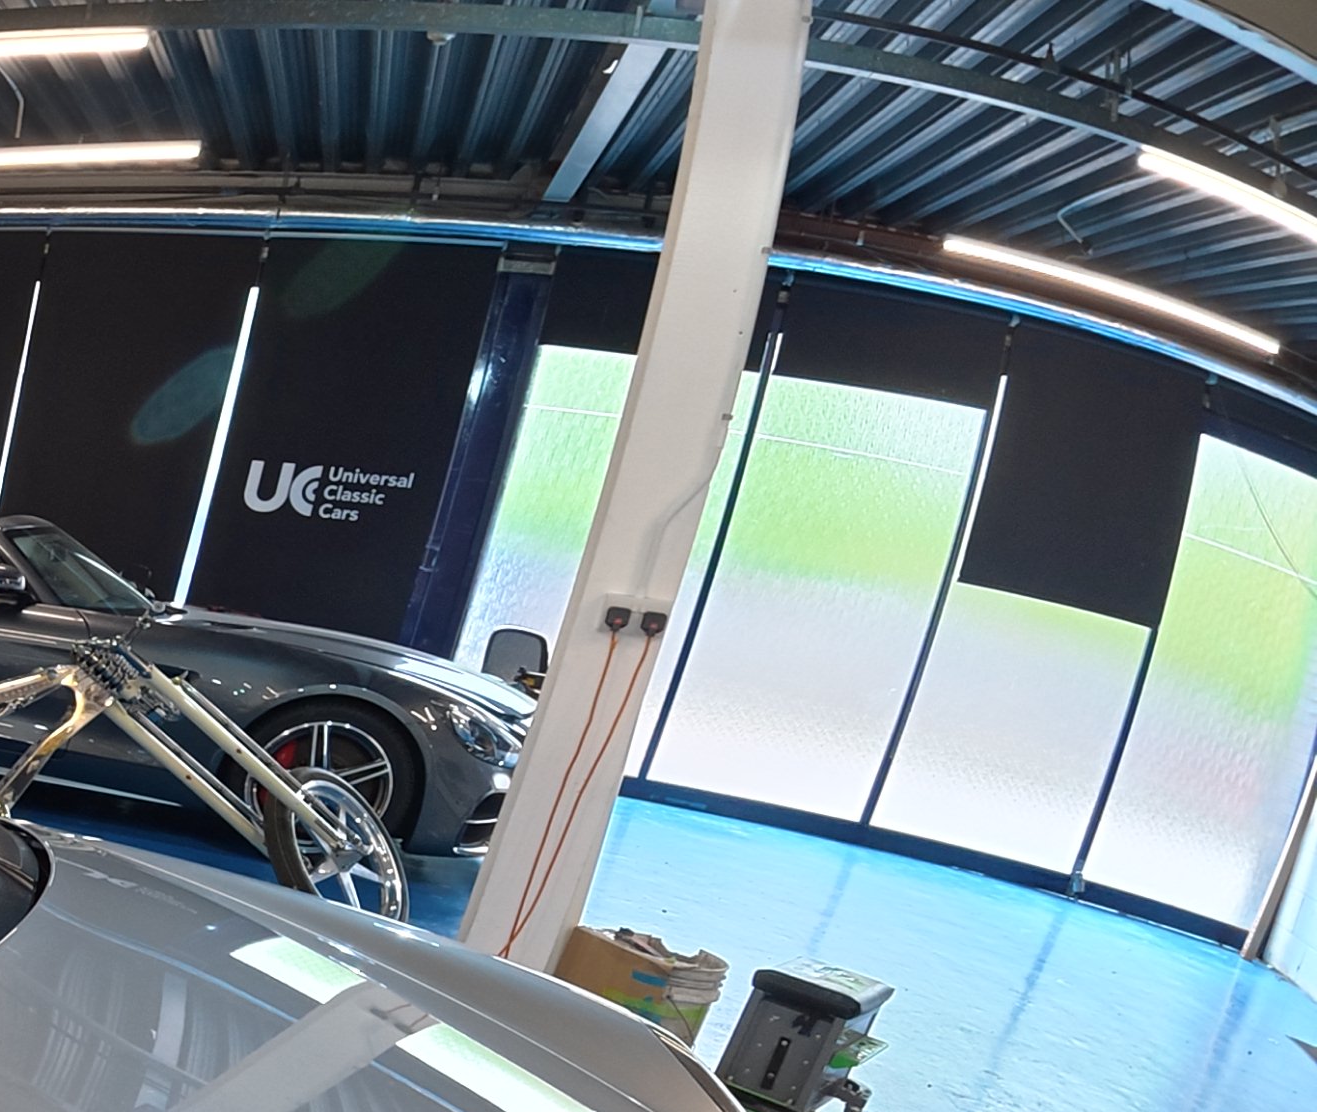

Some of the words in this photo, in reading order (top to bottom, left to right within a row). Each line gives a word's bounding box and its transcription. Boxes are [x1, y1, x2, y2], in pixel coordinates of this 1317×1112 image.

[328, 466, 415, 489] Universal
[323, 485, 386, 505] Classic
[318, 503, 359, 522] Cars
